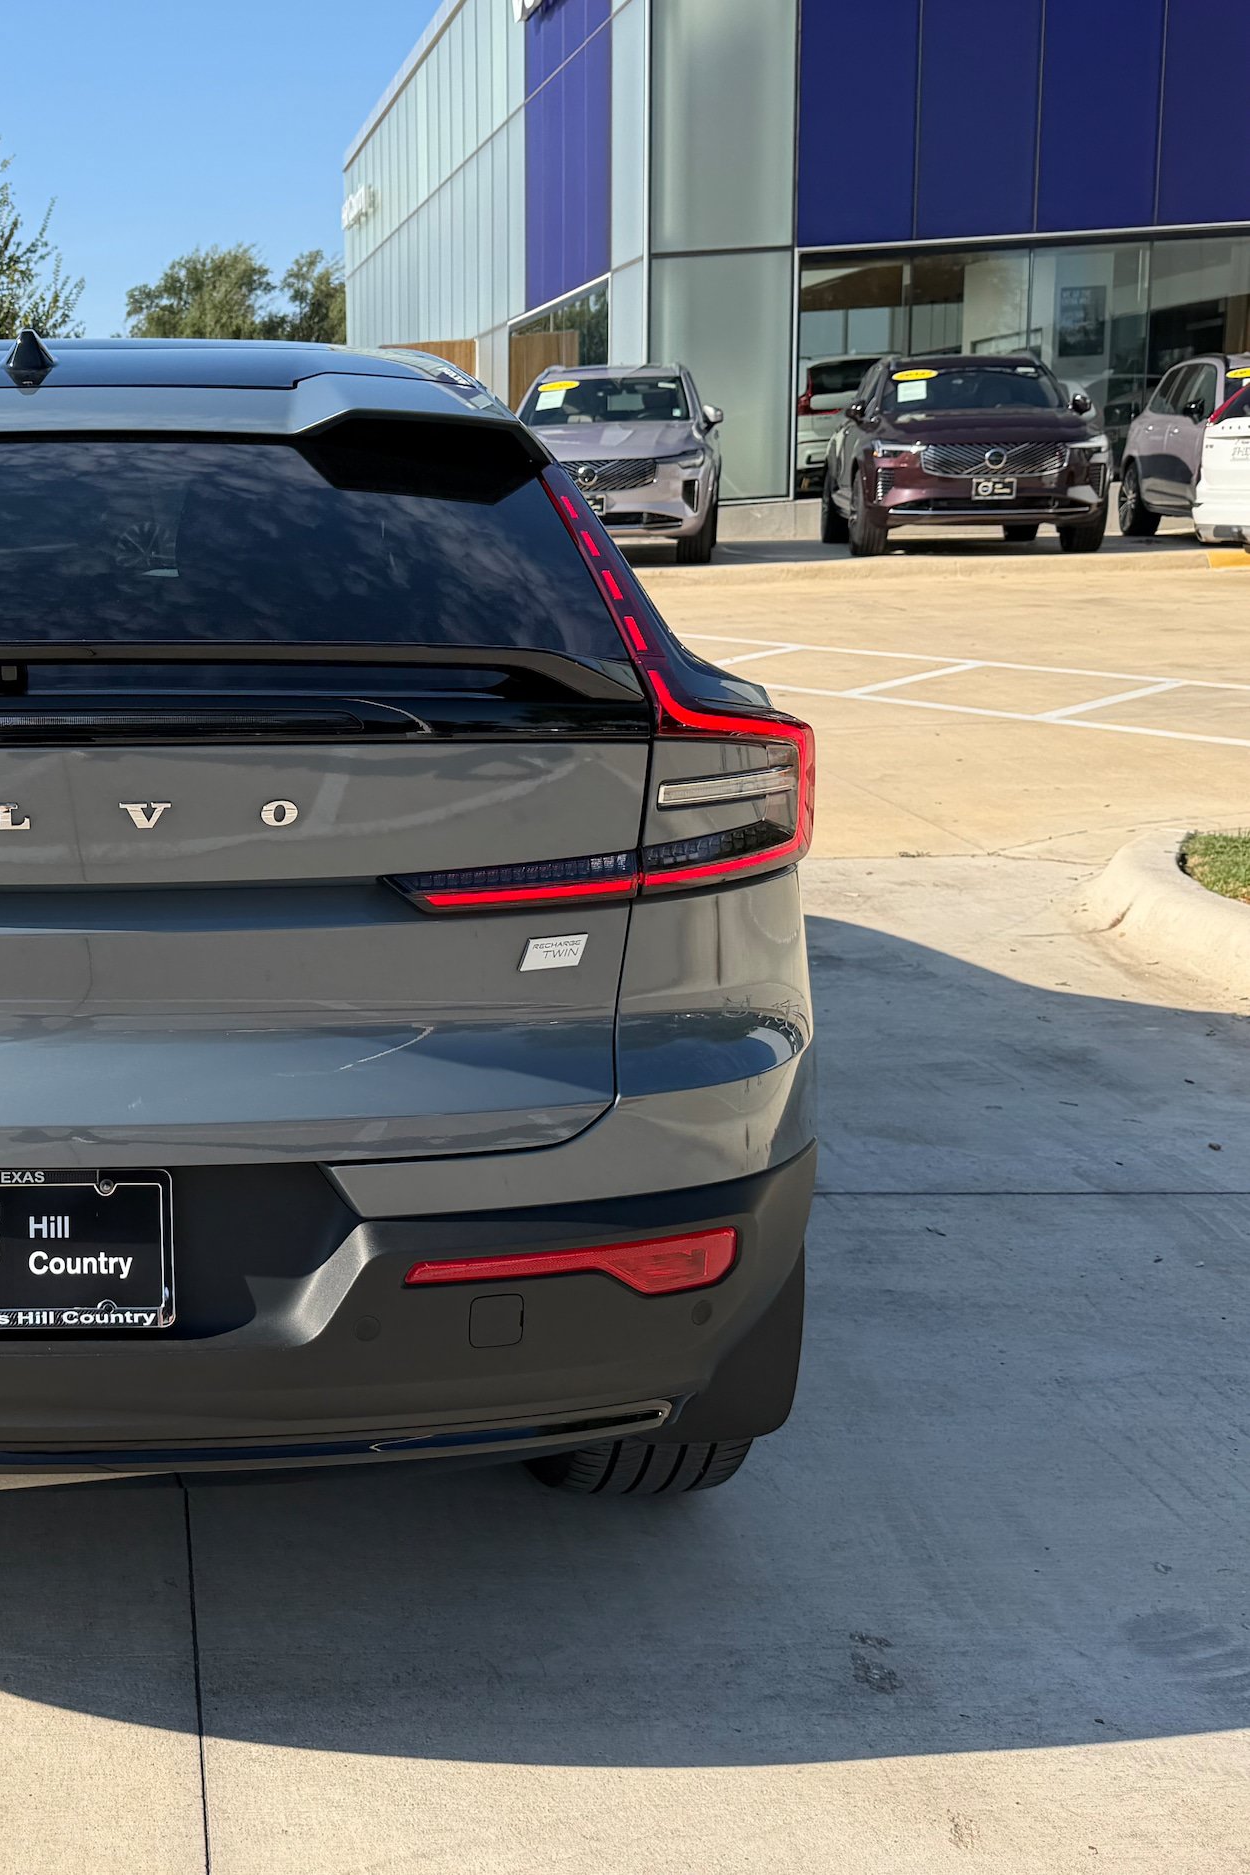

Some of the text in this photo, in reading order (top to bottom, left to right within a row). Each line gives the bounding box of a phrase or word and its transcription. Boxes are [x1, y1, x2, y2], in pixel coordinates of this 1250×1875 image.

[532, 939, 582, 950] RECHARGE
[543, 947, 579, 959] TWIN
[28, 1215, 70, 1239] Hill
[28, 1250, 133, 1280] Country
[17, 1311, 55, 1325] Hill
[61, 1310, 157, 1327] Country
